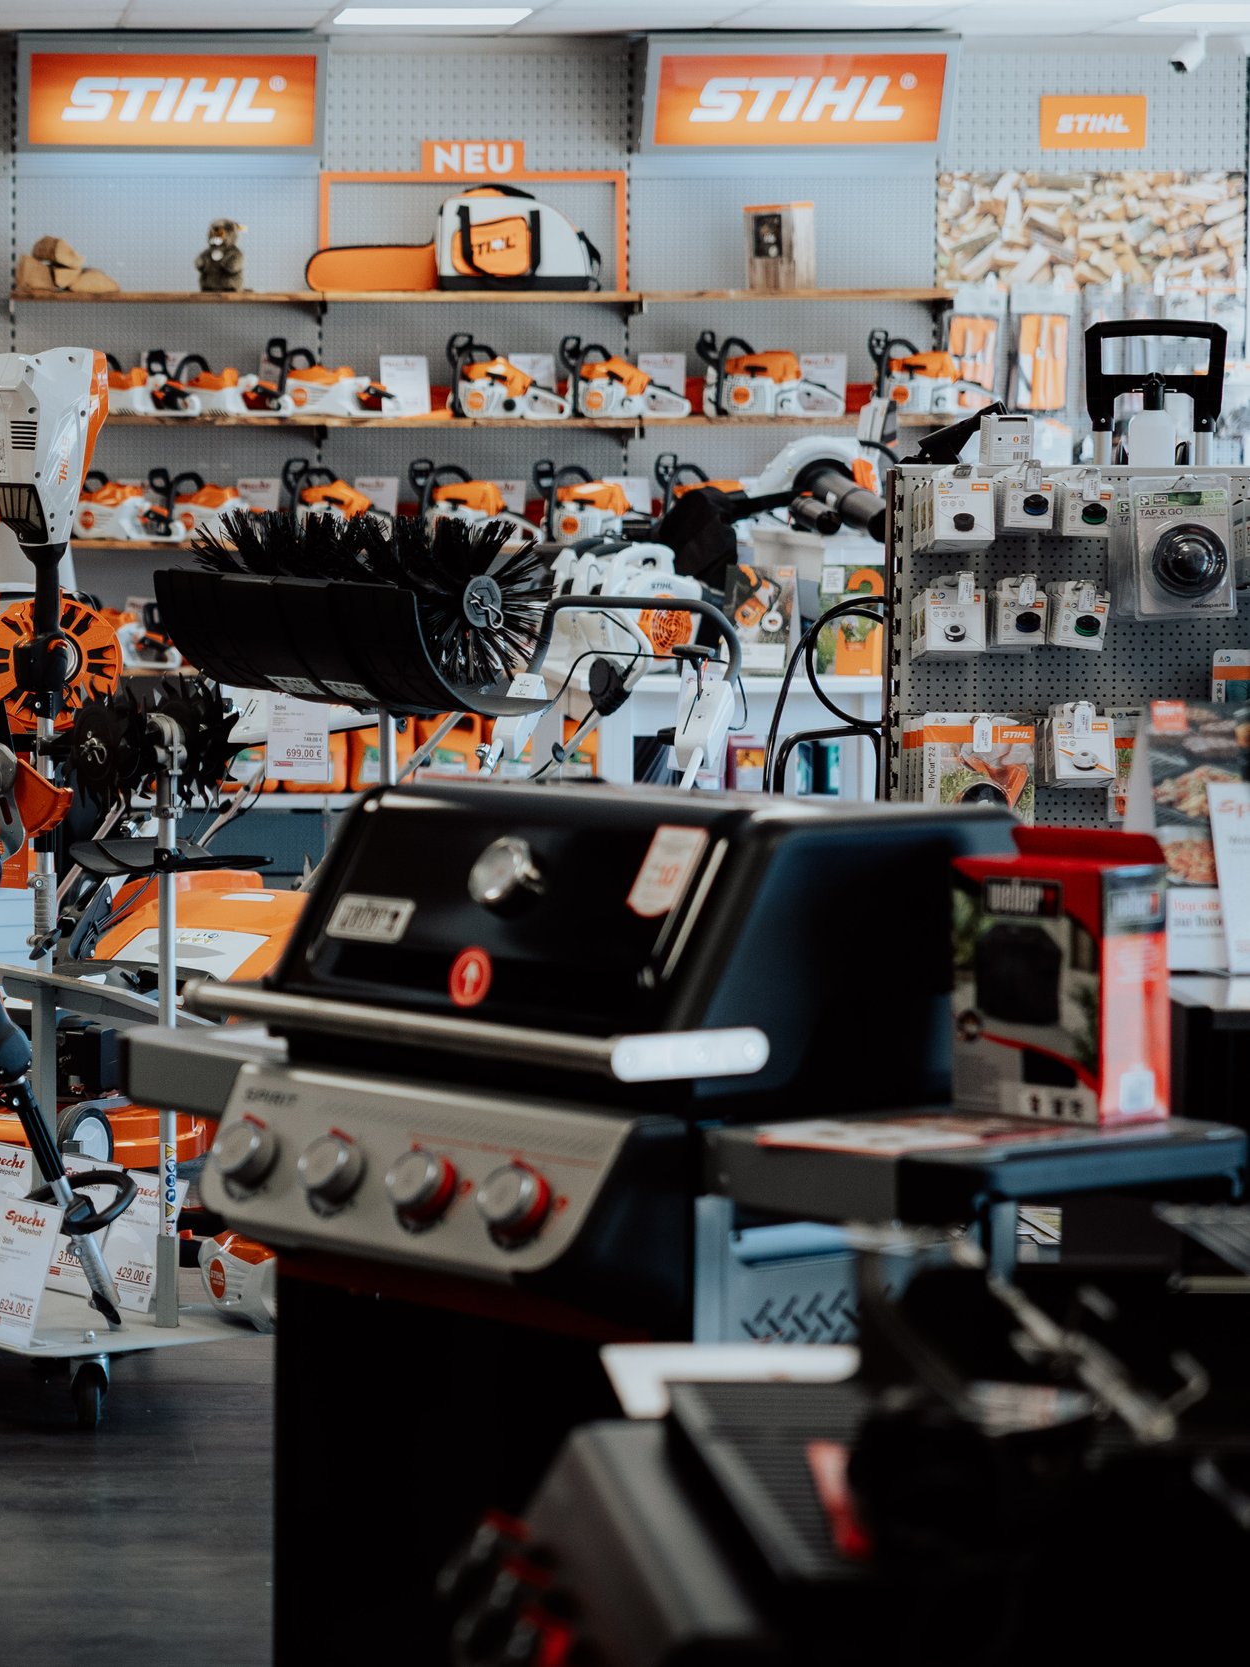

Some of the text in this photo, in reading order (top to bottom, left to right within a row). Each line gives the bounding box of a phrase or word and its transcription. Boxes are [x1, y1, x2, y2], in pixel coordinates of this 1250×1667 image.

[61, 76, 276, 123] STIHL
[688, 75, 904, 122] STIHL
[1056, 114, 1130, 134] STIHL
[434, 143, 514, 174] NEU
[1139, 509, 1158, 517] TAP
[1159, 508, 1167, 516] &
[1168, 508, 1183, 516] GO
[651, 582, 673, 591] STIHL
[1001, 731, 1031, 739] STIHL
[286, 748, 322, 759] 699,00 €
[5, 1209, 46, 1228] Specht
[116, 1265, 152, 1284] 429,00 €
[210, 1270, 224, 1280] STIHL
[0, 1298, 33, 1317] 624,00 €
